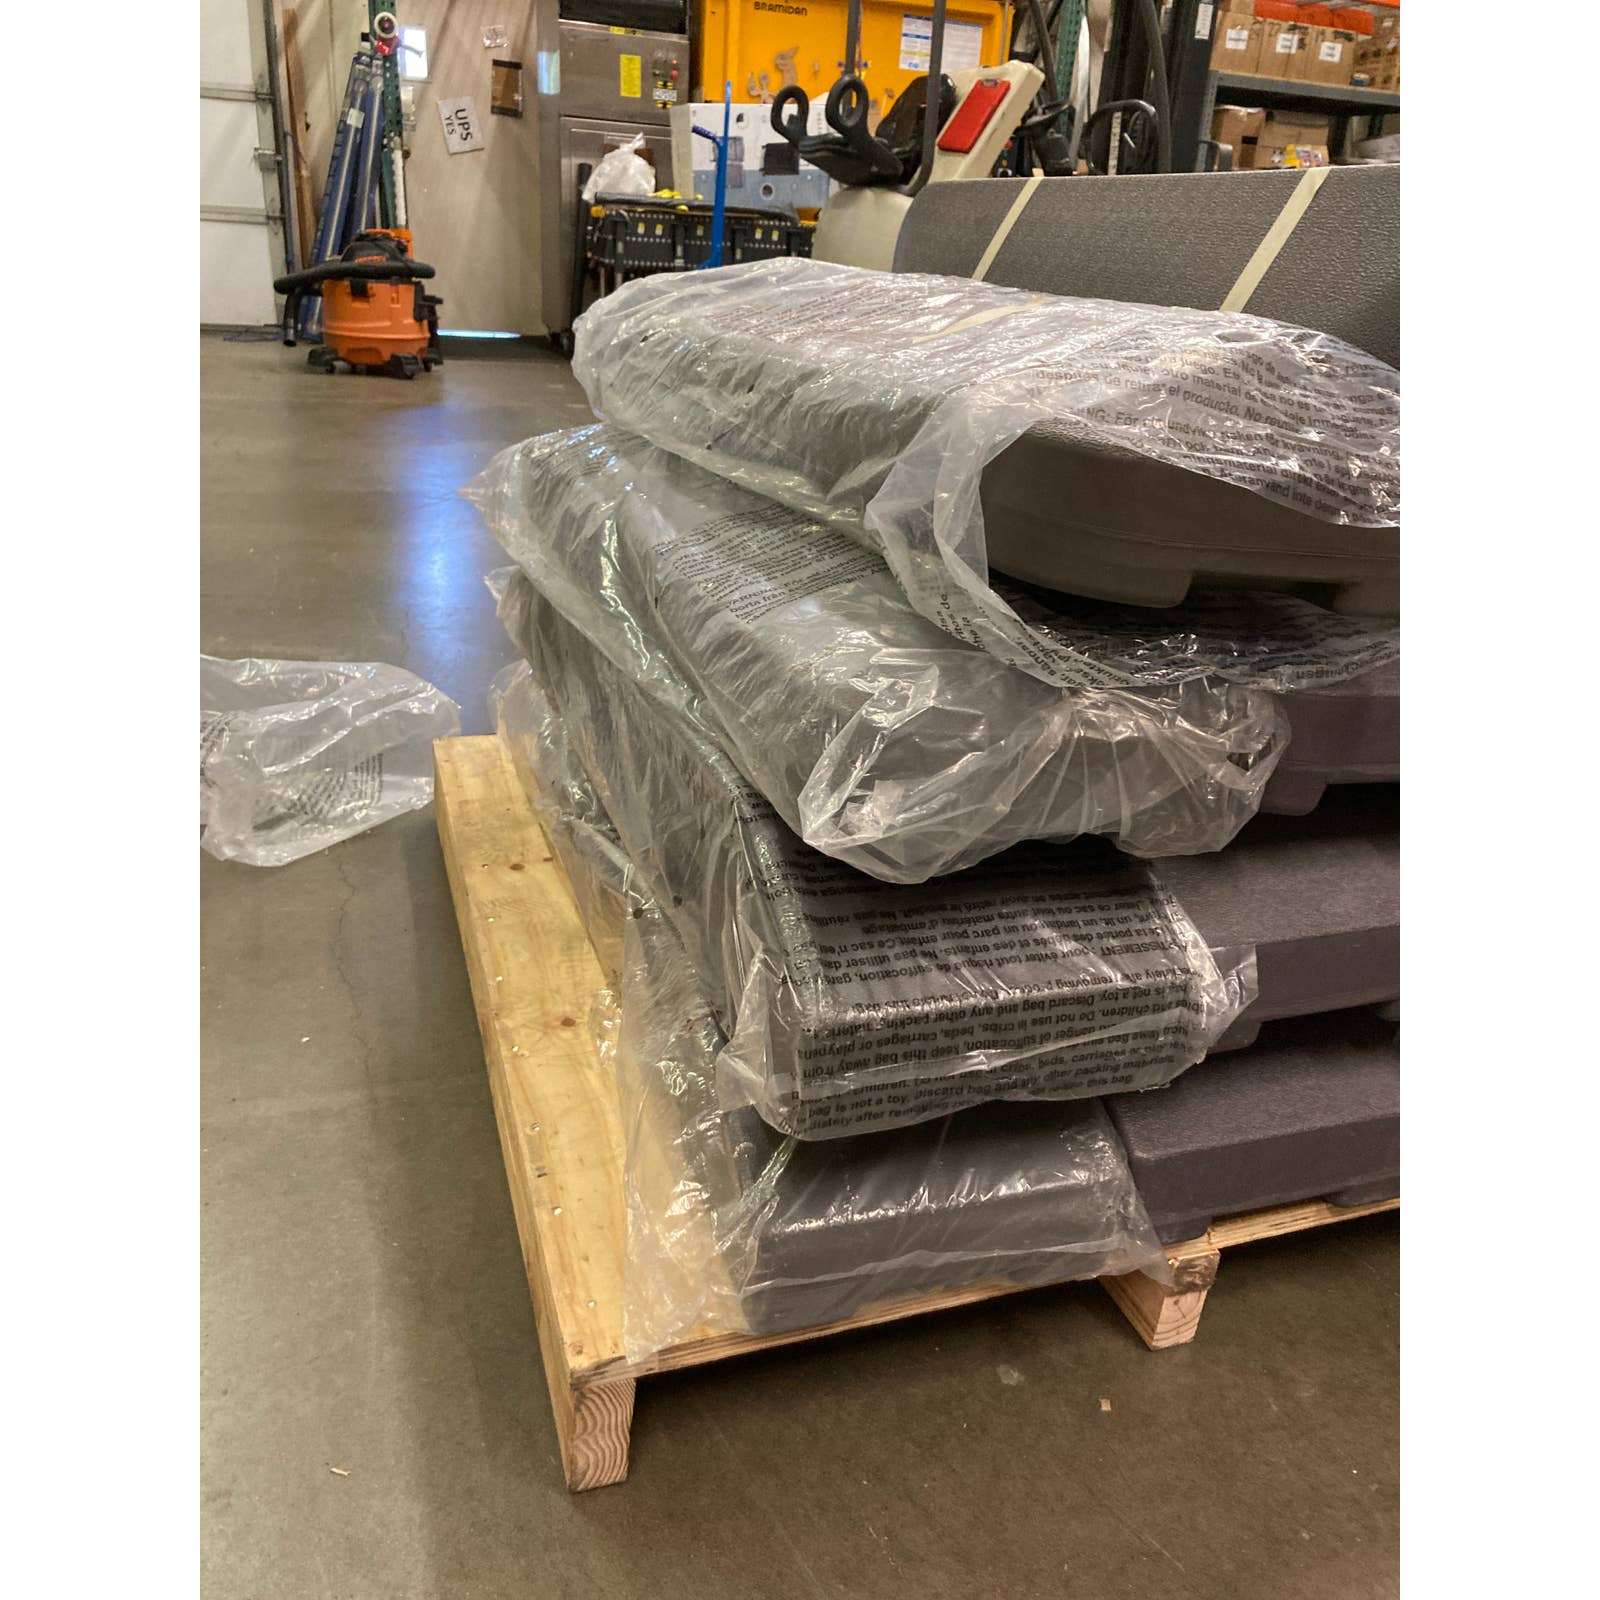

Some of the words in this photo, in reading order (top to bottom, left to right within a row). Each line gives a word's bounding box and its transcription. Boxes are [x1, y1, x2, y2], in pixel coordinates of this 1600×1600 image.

[445, 115, 456, 135] YES
[455, 108, 472, 141] UPS
[1183, 390, 1240, 416] producto.
[995, 955, 1022, 969] tout
[854, 965, 933, 984] suffocation,
[1022, 1000, 1045, 1013] bag
[1049, 995, 1095, 1011] Discard
[934, 1010, 966, 1024] other
[970, 1006, 994, 1019] any
[997, 1004, 1019, 1017] and
[1079, 1011, 1095, 1022] Do
[1099, 1004, 1150, 1017] children.
[1018, 1019, 1027, 1031] in
[1031, 1016, 1052, 1028] use
[1056, 1014, 1076, 1024] not
[941, 1026, 974, 1041] beds,
[1035, 1031, 1051, 1046] of
[858, 1041, 872, 1051] or
[876, 1033, 938, 1049] carriages
[963, 1033, 1037, 1051] suffocation,
[902, 1050, 927, 1064] this
[930, 1045, 960, 1058] keep
[838, 1056, 872, 1075] away
[874, 1052, 898, 1067] bag
[803, 1063, 837, 1080] from
[851, 1098, 873, 1110] not
[875, 1096, 884, 1106] a
[967, 1083, 992, 1094] bag
[994, 1080, 1018, 1091] and
[1074, 1063, 1122, 1078] packing
[855, 1111, 885, 1123] after
